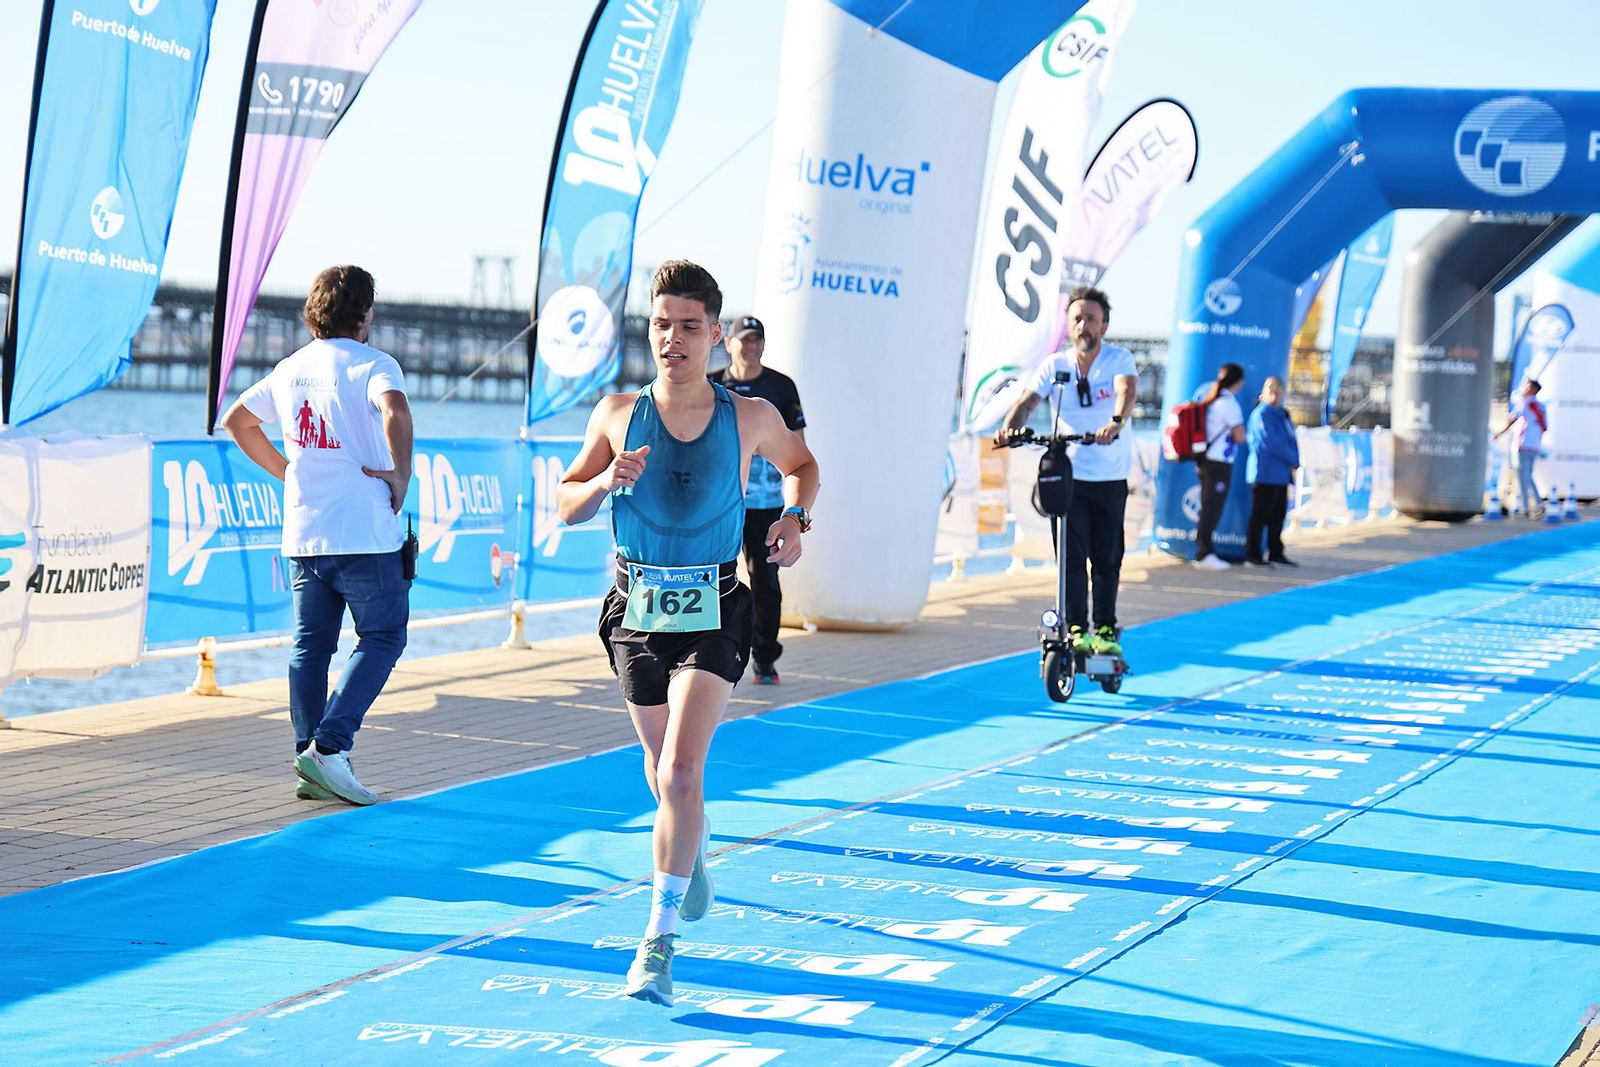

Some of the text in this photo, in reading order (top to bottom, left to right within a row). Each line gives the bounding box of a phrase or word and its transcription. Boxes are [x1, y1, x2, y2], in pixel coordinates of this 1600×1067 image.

[71, 10, 192, 60] Puerto de Huelva
[1057, 31, 1109, 63] CSIF
[289, 76, 345, 109] 1790
[859, 198, 914, 215] original
[995, 125, 1063, 323] CSIF
[38, 240, 158, 276] Puerto de Huelva
[815, 257, 904, 276] Ayuntamiento de
[812, 272, 899, 298] HUELVA
[1229, 322, 1271, 340] Huelva
[163, 459, 219, 586] 10
[210, 482, 283, 529] HUELVA
[414, 453, 504, 563] 10 HUELVA
[32, 523, 113, 557] Fundación
[26, 564, 108, 594] ATLANTIC
[663, 573, 694, 582] AVATEL
[642, 588, 703, 616] 162
[1073, 836, 1191, 855] 10
[1017, 859, 1144, 881] 10
[771, 873, 1089, 911] 10 HUELVA
[707, 909, 1028, 946] 10 HUELV
[799, 953, 957, 982] 10
[704, 993, 876, 1025] 10
[357, 1026, 616, 1058] HUELVA
